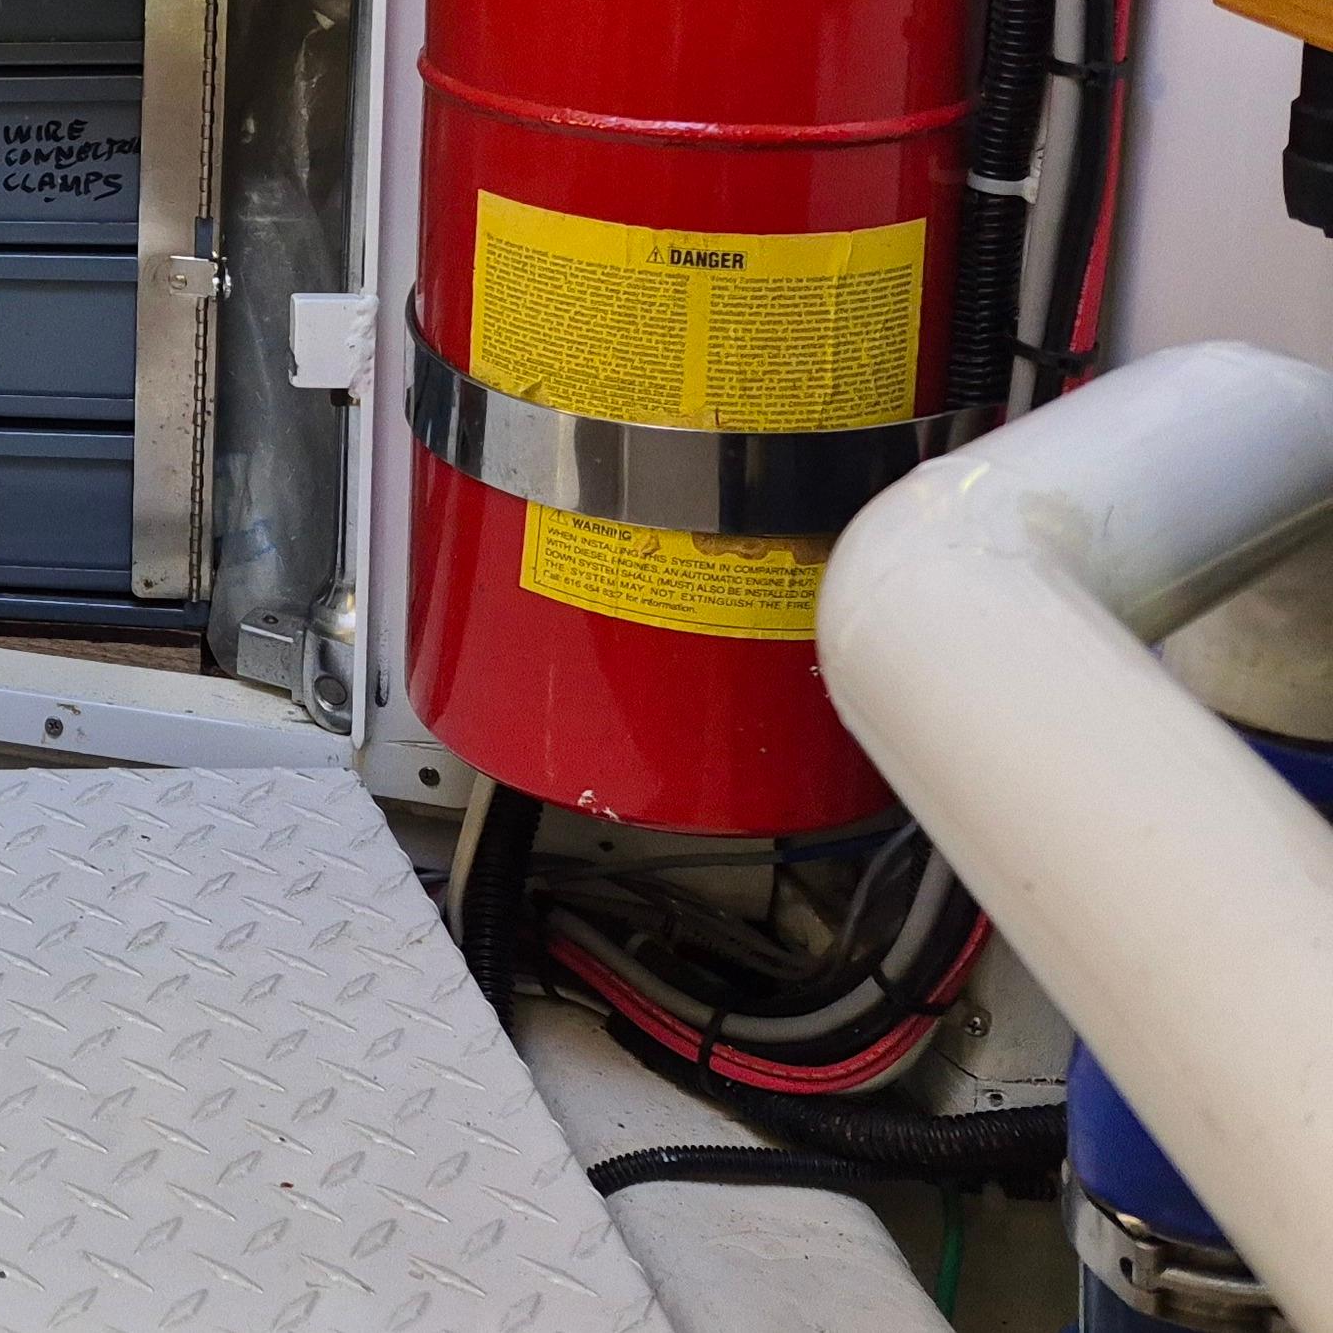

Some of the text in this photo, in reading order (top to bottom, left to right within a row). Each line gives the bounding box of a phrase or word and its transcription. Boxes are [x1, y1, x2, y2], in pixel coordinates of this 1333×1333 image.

[3, 119, 88, 142] WIRE
[2, 171, 123, 201] CLAMPS
[670, 249, 745, 269] DANGER
[572, 517, 632, 541] WARNING
[546, 537, 571, 551] WITH
[574, 544, 608, 563] DIESEL
[663, 566, 679, 577] AN
[682, 568, 742, 586] AUTOMATIC
[746, 577, 785, 588] ENGINE
[547, 527, 578, 542] WHEN
[581, 537, 638, 559] INSTALLING
[643, 551, 667, 564] THIS
[671, 556, 715, 571] SYSTEM
[719, 563, 731, 572] IN
[545, 548, 815, 599] DOWN SYSTEM SHALL (MUST) ALSO BE INSTALLED OR
[545, 559, 565, 571] THE
[571, 567, 616, 587] SYSTEM
[620, 579, 645, 593] MAY
[651, 586, 675, 599] NOT
[680, 593, 754, 608] EXTINGUISH
[759, 600, 781, 609] THE
